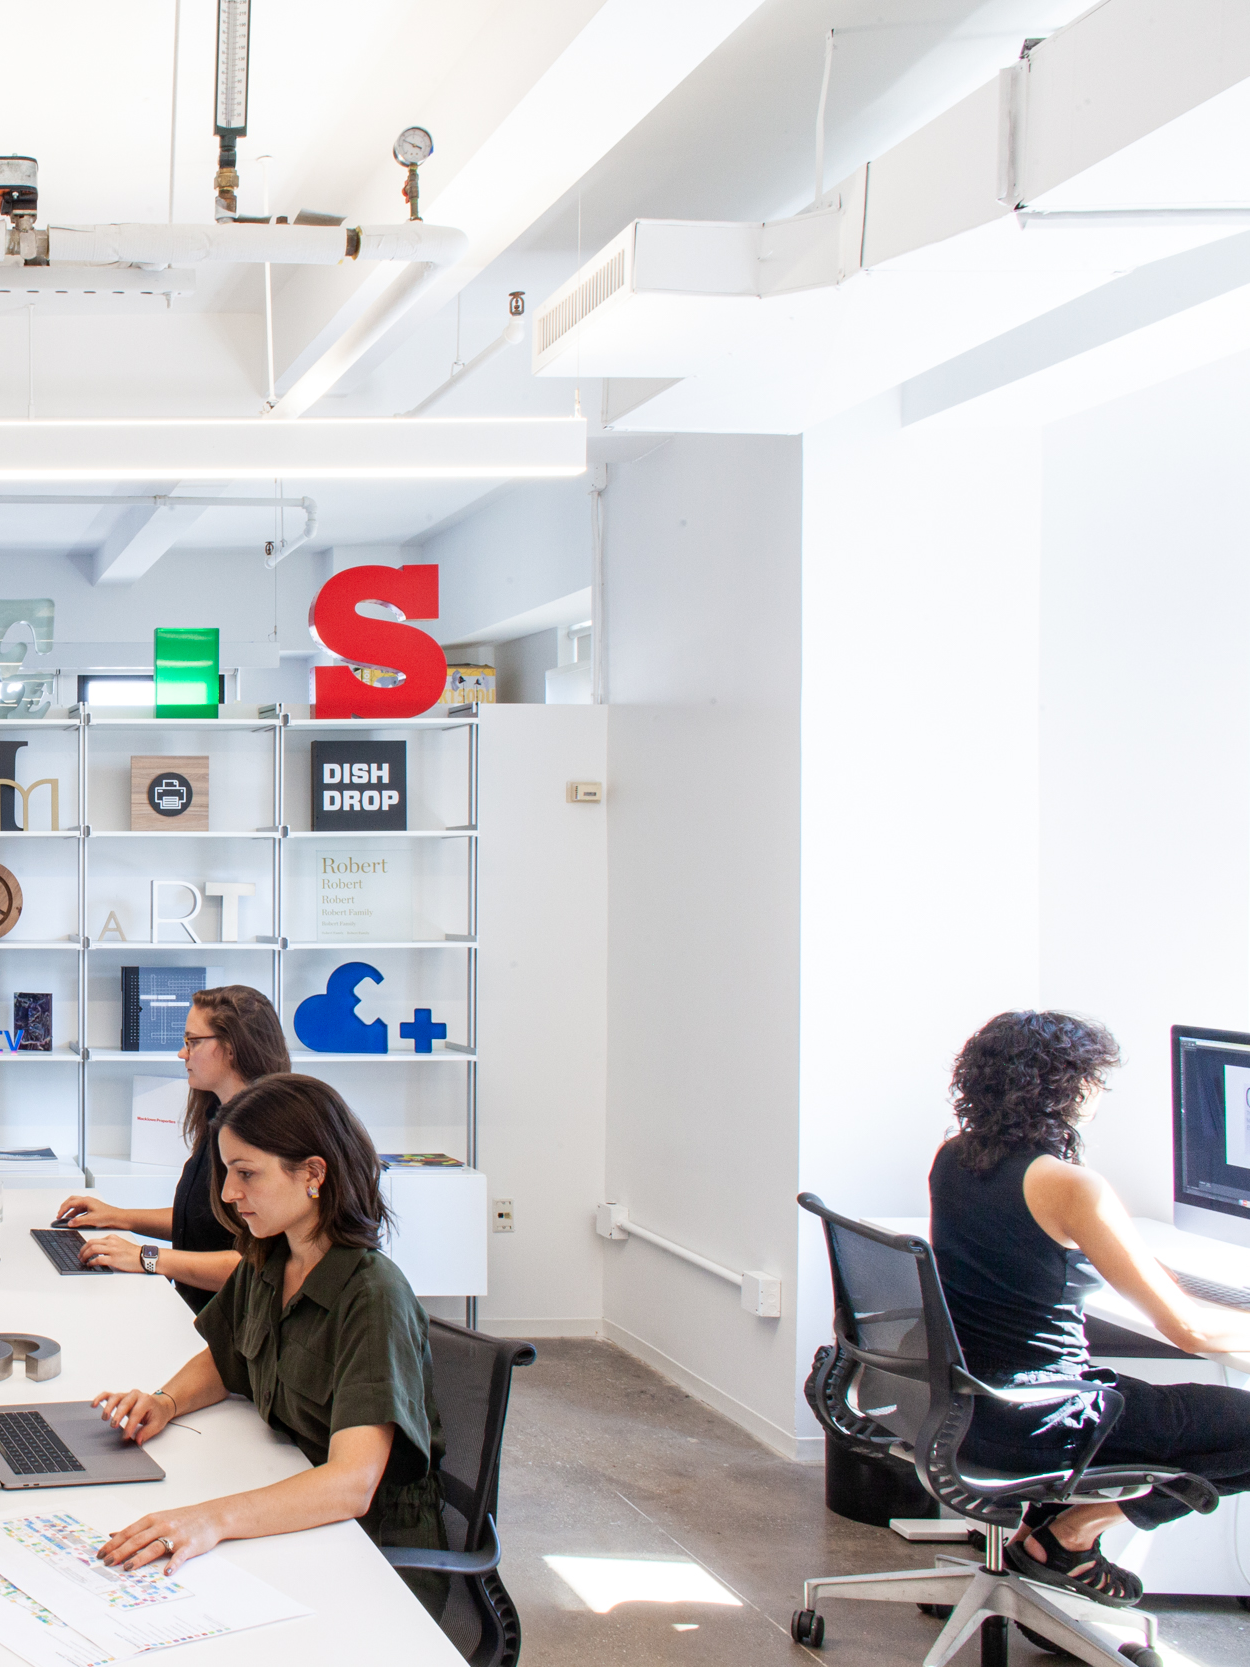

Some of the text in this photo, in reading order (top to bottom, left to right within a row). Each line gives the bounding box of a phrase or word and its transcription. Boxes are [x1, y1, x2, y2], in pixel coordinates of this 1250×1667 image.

[309, 563, 447, 719] S
[323, 763, 390, 784] DISH
[323, 790, 400, 811] DROP
[321, 857, 388, 874] Robert
[321, 878, 363, 889] Robert
[321, 895, 355, 904] Robert
[321, 908, 374, 918] Robert Family
